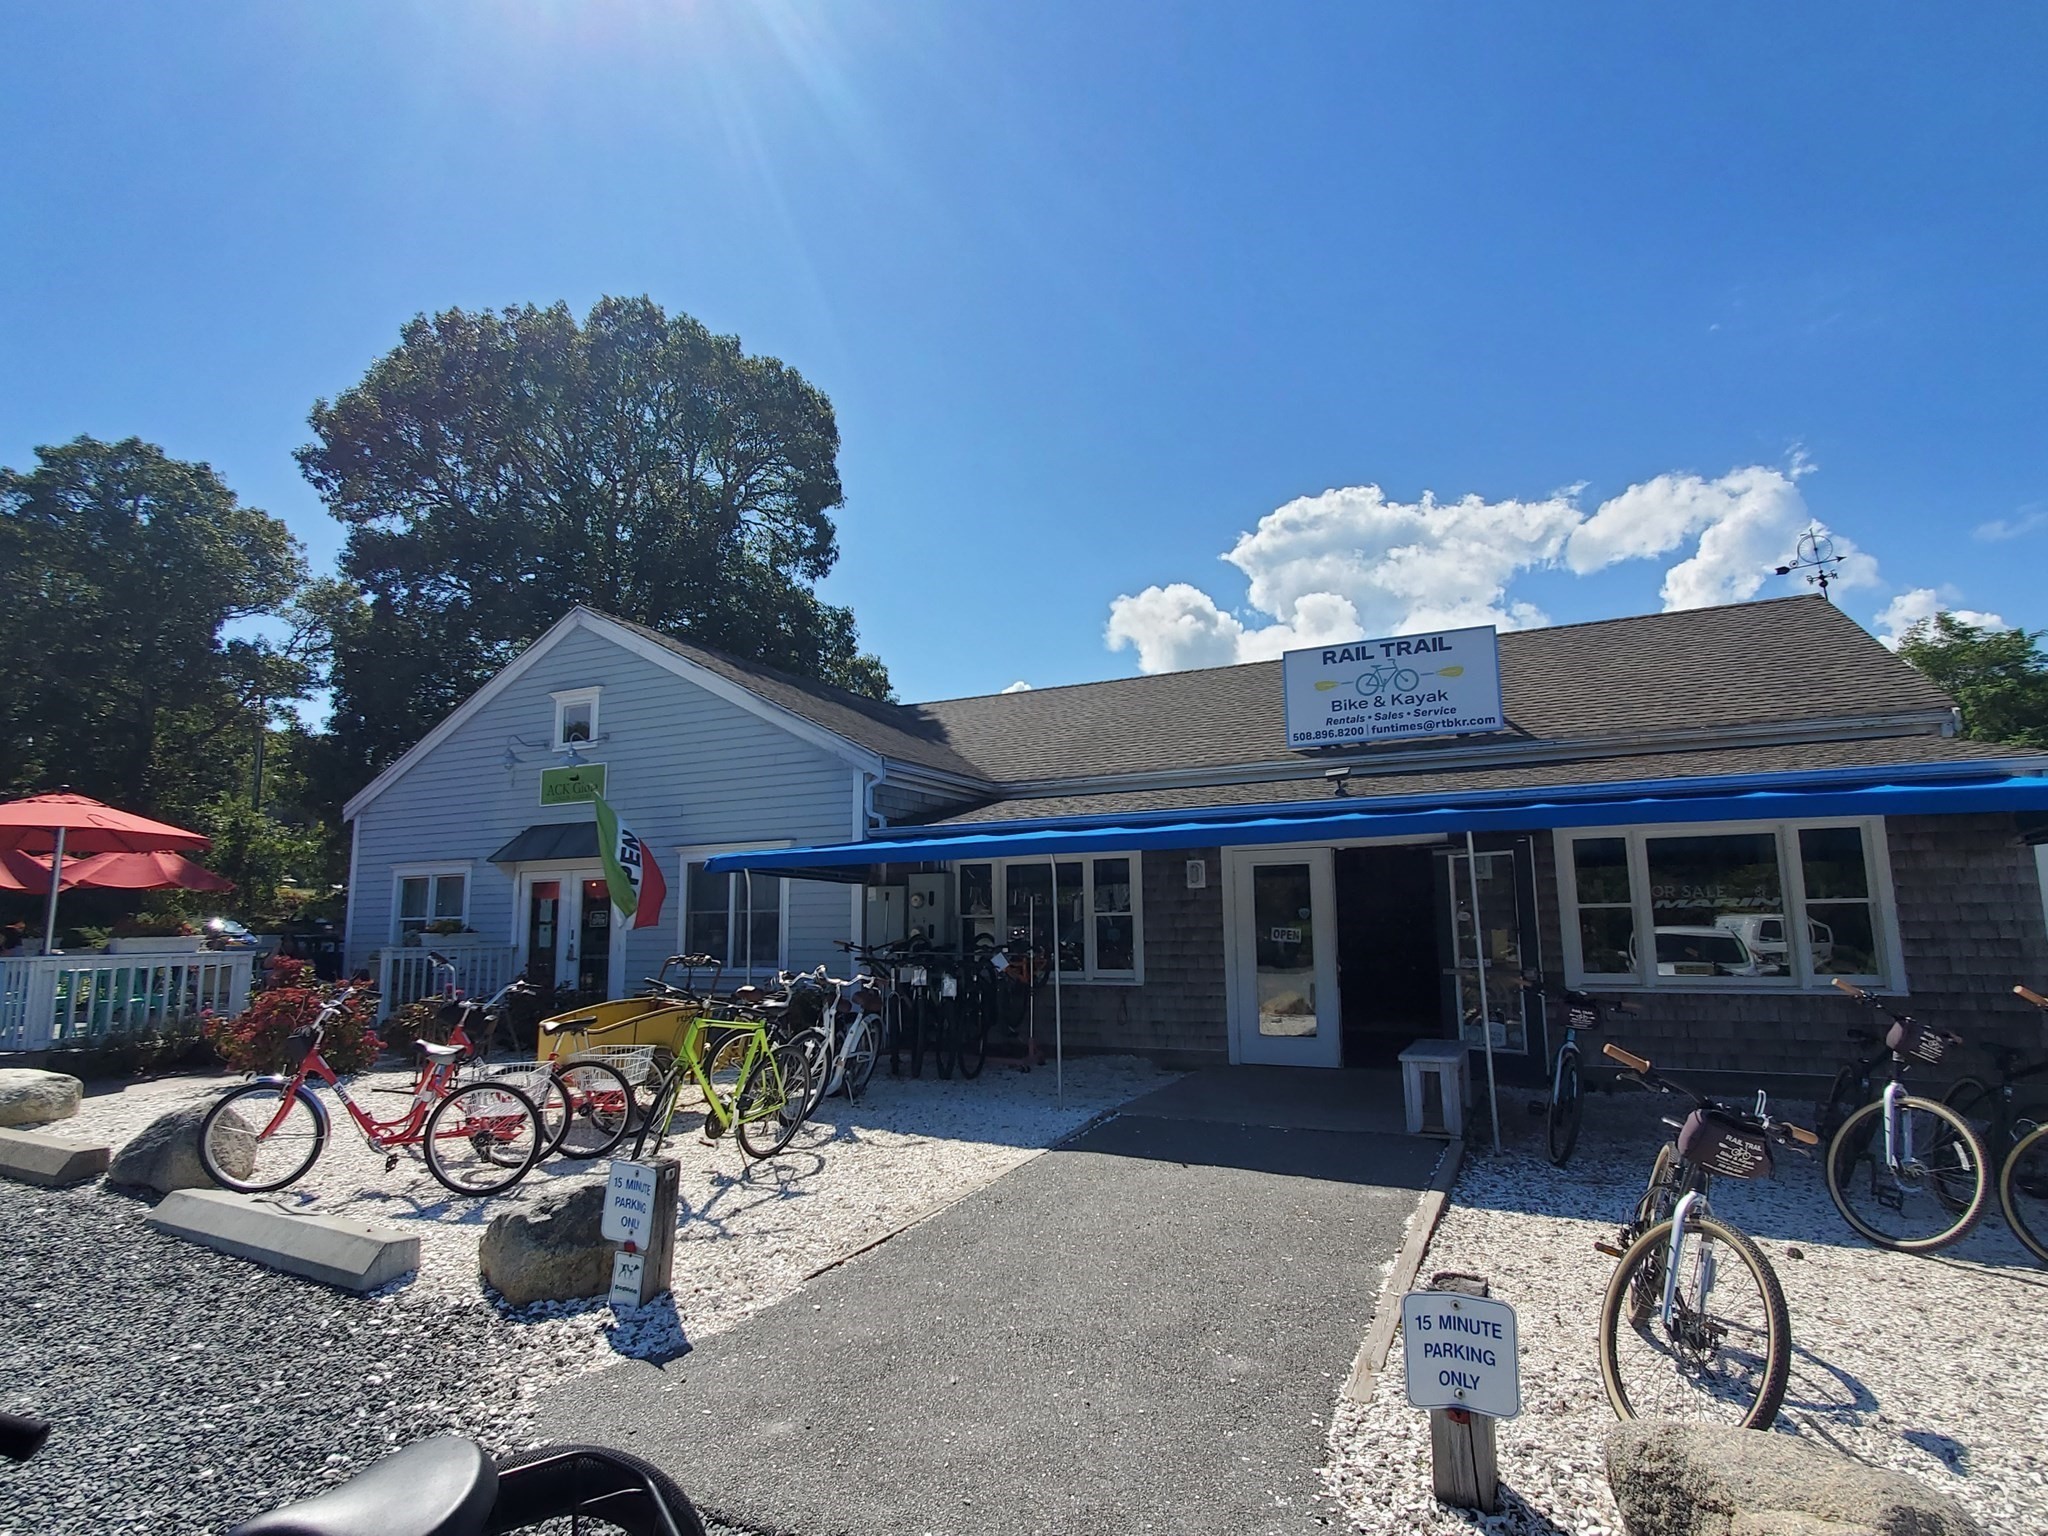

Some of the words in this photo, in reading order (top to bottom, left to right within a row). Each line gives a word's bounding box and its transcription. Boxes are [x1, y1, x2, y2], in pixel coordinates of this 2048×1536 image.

[1322, 645, 1374, 665] RAIL
[1379, 637, 1452, 658] TRAIL
[1331, 697, 1369, 712] Bike
[1373, 696, 1386, 708] &
[1391, 689, 1449, 707] Kayak
[1326, 713, 1365, 726] Rentals
[1374, 711, 1404, 722] Sales
[1413, 706, 1457, 718] Service
[1293, 727, 1364, 742] 508.896.8200
[1371, 716, 1496, 734] funtimes@rtbkr.com
[547, 784, 570, 796] ACK
[620, 829, 641, 898] PEN
[1681, 884, 1727, 898] SALE
[1654, 897, 1782, 909] MARIN
[1273, 929, 1299, 940] OPEN
[1725, 1134, 1744, 1147] RAIL
[1745, 1141, 1763, 1152] TRAIL
[614, 1176, 623, 1188] 15
[626, 1179, 651, 1196] MINUTE
[615, 1196, 646, 1214] PARKING
[1415, 1315, 1432, 1330] 15
[1439, 1315, 1502, 1339] MINUTE
[1424, 1342, 1496, 1367] PARKING
[1439, 1370, 1480, 1390] ONLY
